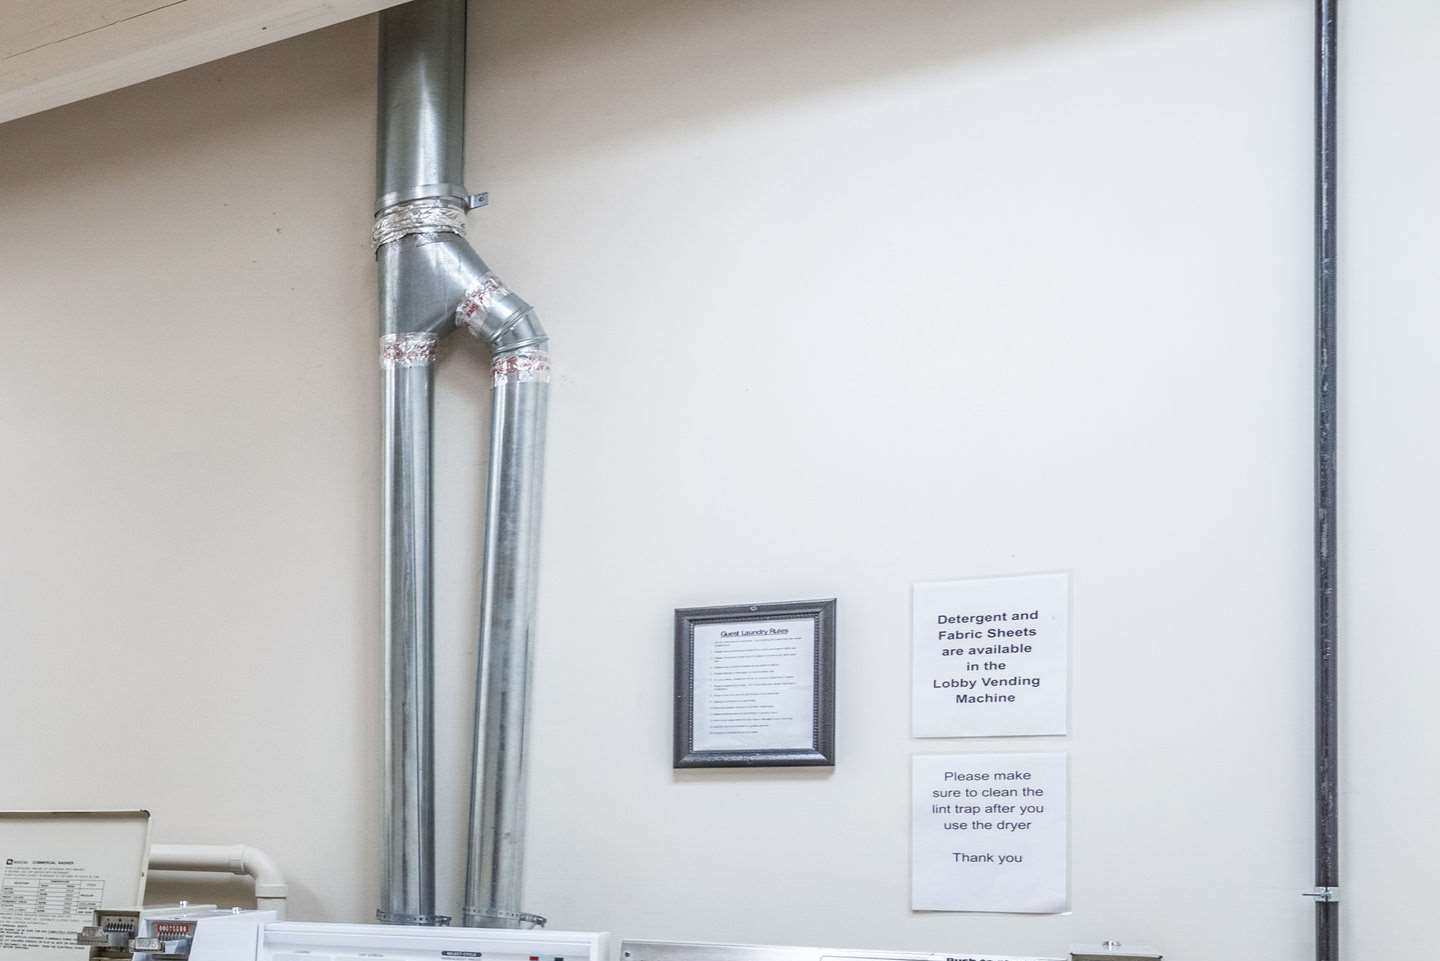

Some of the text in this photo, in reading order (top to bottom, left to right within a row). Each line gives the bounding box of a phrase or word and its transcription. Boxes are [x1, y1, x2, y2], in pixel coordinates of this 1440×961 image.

[937, 609, 1039, 625] Detergent and
[741, 629, 769, 637] Laundry
[938, 627, 1038, 641] Fabric Sheets
[941, 643, 1033, 657] are available
[966, 660, 1007, 672] in the
[933, 675, 1041, 690] Lobby Vending
[955, 692, 1016, 704] Machine
[944, 770, 1032, 782] Please make
[932, 786, 1044, 799] sure to clean the
[932, 803, 1045, 817] lint trap after you
[943, 819, 1032, 833] use the dryer
[951, 852, 1023, 865] Thank you
